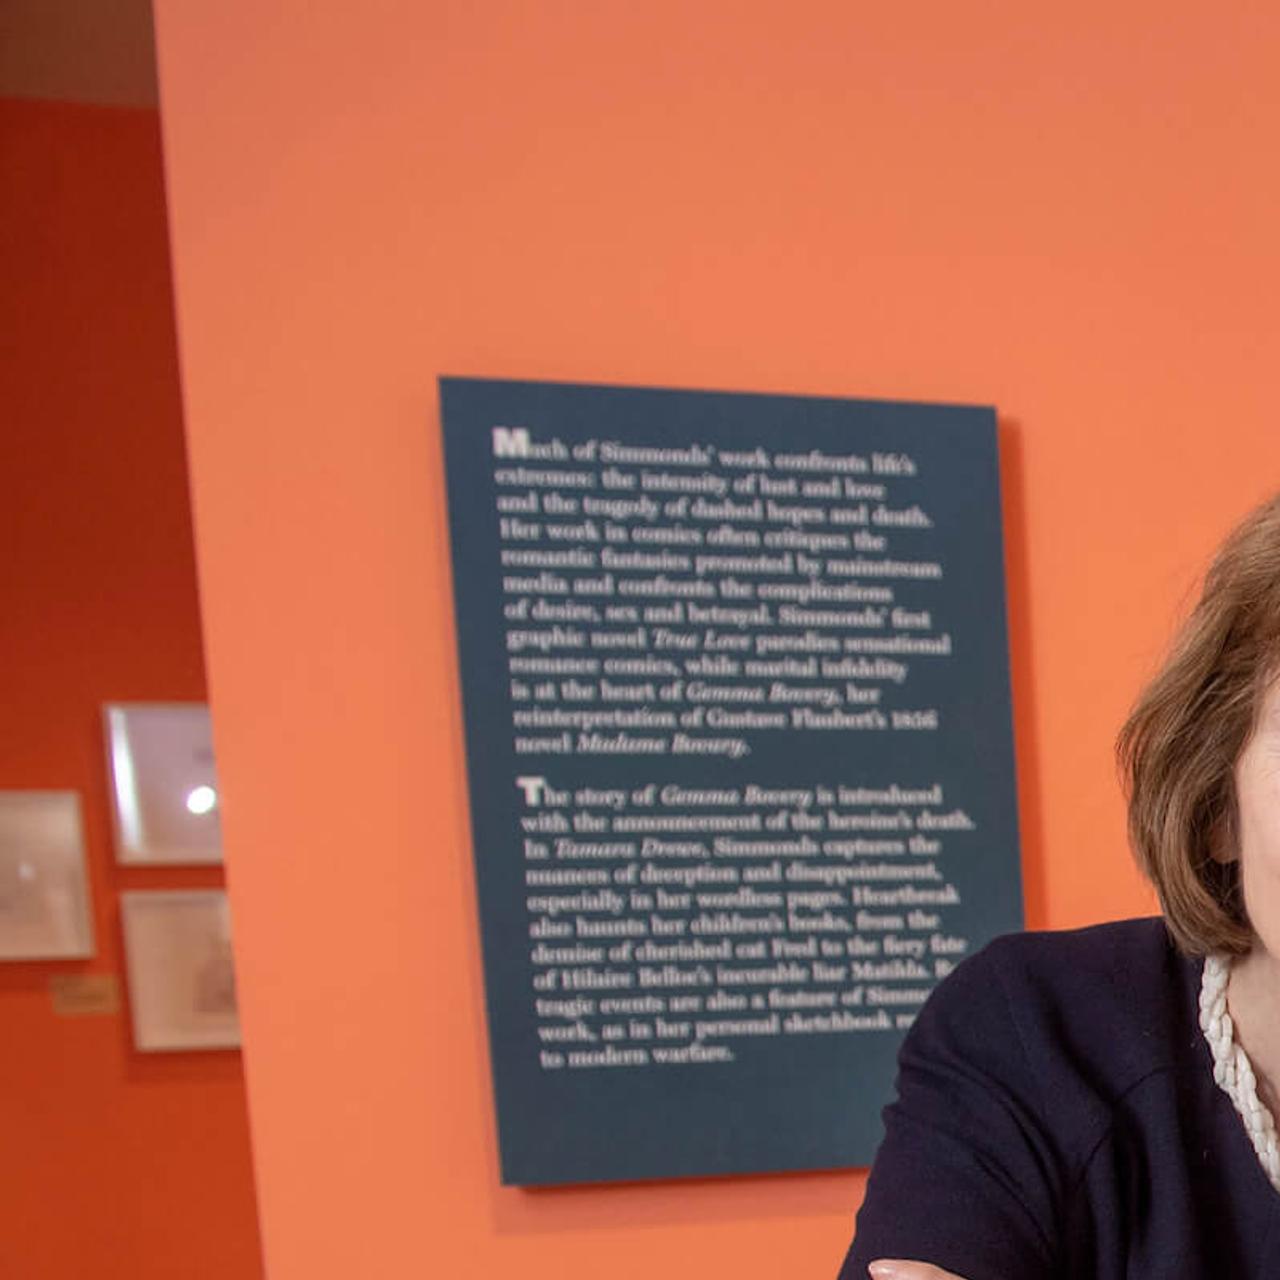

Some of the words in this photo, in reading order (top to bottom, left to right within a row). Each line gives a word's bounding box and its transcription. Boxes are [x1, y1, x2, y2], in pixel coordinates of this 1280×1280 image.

[490, 429, 568, 460] Much
[599, 440, 711, 467] Simmonds'
[719, 445, 769, 469] work
[774, 447, 867, 473] confronts
[871, 452, 916, 475] life's
[492, 462, 595, 489] extremes:
[640, 468, 729, 500] intensity
[758, 473, 798, 497] lust
[801, 475, 842, 499] and
[844, 477, 886, 500] love
[495, 488, 539, 513] and
[582, 492, 659, 523] tragedy
[690, 496, 764, 521] dashed
[766, 499, 826, 528] hopes
[829, 501, 869, 524] and
[871, 503, 933, 527] death.
[498, 516, 540, 540] Her
[547, 518, 598, 542] work
[631, 521, 702, 545] comics
[706, 523, 759, 547] often
[764, 525, 849, 555] critiques
[499, 543, 594, 569] romantic
[600, 547, 689, 571] fantasies
[694, 550, 794, 580] promoted
[826, 554, 942, 579] mainstream
[501, 570, 567, 594] media
[573, 572, 614, 595] and
[618, 573, 714, 598] confronts
[757, 577, 894, 608] complications
[530, 598, 600, 623] desire,
[604, 605, 639, 623] sex
[642, 601, 685, 624] and
[686, 602, 772, 631] betrayal.
[777, 604, 886, 628] Simmonds'
[890, 607, 931, 629] first
[504, 624, 585, 653] graphic
[589, 626, 648, 649] novel
[652, 627, 698, 650] True
[703, 628, 751, 651] Love
[754, 630, 840, 658] parodies
[843, 632, 952, 655] sensational
[508, 656, 598, 674] romance
[603, 652, 677, 677] comics,
[685, 654, 739, 677] while
[744, 655, 818, 678] marital
[821, 657, 908, 685] infidelity
[600, 679, 655, 702] heart
[686, 680, 763, 703] Gemma
[846, 683, 881, 705] her
[511, 704, 676, 733] reinterpretation
[705, 706, 785, 729] Gustave
[791, 707, 886, 730] Flaubert's
[514, 730, 572, 753] novel
[577, 731, 665, 753] Madame
[517, 776, 567, 805] The
[576, 783, 625, 811] story
[660, 784, 737, 805] Gemma
[838, 784, 943, 805] introduced
[519, 810, 568, 832] with
[612, 810, 761, 832] announcement
[827, 810, 911, 831] heroine's
[916, 810, 977, 831] death.
[523, 837, 547, 858] In
[555, 836, 635, 858] Tamara
[713, 836, 818, 857] Simmonds
[823, 835, 904, 862] captures
[524, 868, 608, 885] nuances
[640, 862, 738, 889] deception
[743, 862, 782, 883] and
[785, 861, 943, 888] disappointment,
[525, 889, 622, 917] especially
[656, 888, 689, 910] her
[698, 887, 780, 909] wordless
[787, 892, 841, 914] pages.
[852, 886, 960, 907] Heartbreak
[528, 915, 570, 937] also
[575, 914, 645, 937] haunts
[650, 914, 684, 935] her
[690, 912, 783, 935] children's
[788, 912, 848, 935] books,
[856, 911, 903, 932] from
[529, 941, 603, 964] demise
[634, 939, 732, 962] cherished
[735, 938, 767, 960] cat
[771, 938, 818, 959] Fred
[882, 936, 925, 962] fiery
[930, 935, 967, 956] fate
[561, 967, 632, 989] Hilaire
[638, 965, 712, 988] Belloc's
[812, 962, 846, 984] liar
[534, 993, 594, 1022] tragic
[599, 992, 663, 1015] events
[669, 996, 700, 1013] are
[706, 990, 746, 1012] also
[768, 988, 836, 1010] feature
[655, 1017, 689, 1038] her
[694, 1014, 780, 1043] personal
[785, 1011, 890, 1035] sketchbook
[567, 1043, 647, 1067] modern
[652, 1041, 733, 1064] warfare.
